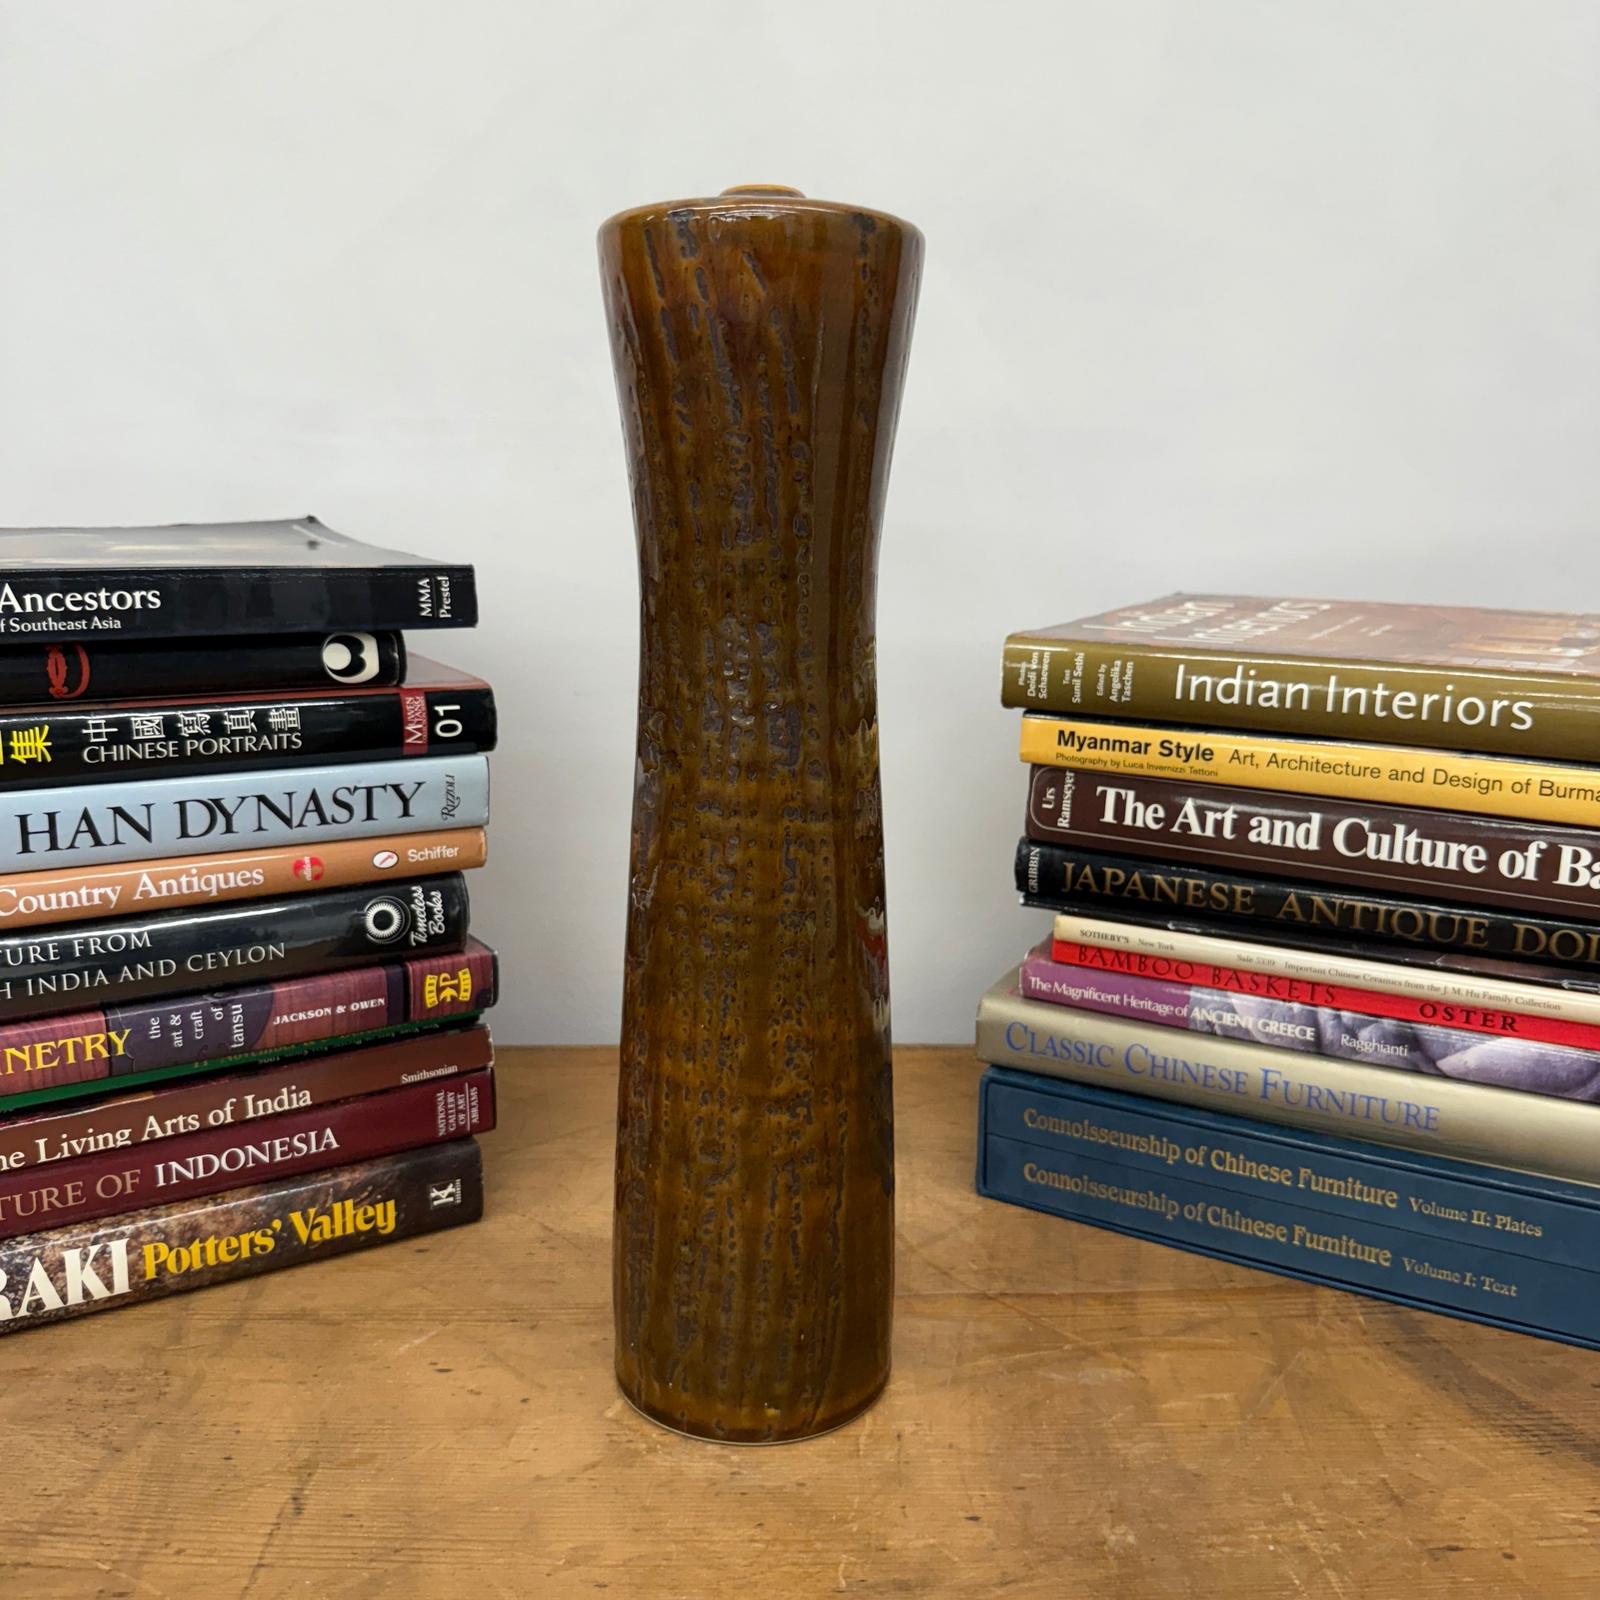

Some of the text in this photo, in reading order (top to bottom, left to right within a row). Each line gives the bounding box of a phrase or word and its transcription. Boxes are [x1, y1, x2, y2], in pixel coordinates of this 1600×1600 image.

[0, 582, 161, 613] Ancestors
[417, 578, 432, 617] MMA
[436, 576, 451, 618] Prestel
[10, 616, 87, 632] Southeast
[91, 615, 122, 630] Asia
[1027, 652, 1039, 697] Deidi von
[1039, 652, 1051, 699] Schaewen
[1072, 652, 1085, 703] Sunil Sethi
[1109, 660, 1122, 702] Angelika
[1121, 661, 1134, 702] Taschen
[1175, 664, 1535, 730] Indian Interiors
[433, 704, 463, 738] 01
[0, 724, 52, 765] 集
[83, 733, 302, 764] CHINESE PORTRAITS
[1056, 752, 1218, 777] Photography by Luca Invernizzi Tettoni
[1057, 729, 1152, 755] Myanmar
[1158, 739, 1214, 763] Style
[1228, 749, 1260, 769] Art,
[1266, 752, 1381, 779] Architecture
[1388, 767, 1425, 784] and
[1433, 768, 1503, 795] Design
[1511, 778, 1532, 794] of
[14, 781, 427, 855] HAN DYNASTY
[1042, 787, 1055, 809] Urs
[1057, 770, 1076, 828] Ramseyer
[408, 846, 460, 862] Schiffer
[1096, 786, 1165, 830] The
[1170, 797, 1238, 840] Art
[1248, 811, 1323, 850] and
[1332, 817, 1488, 874] Culture
[1498, 840, 1548, 882] of
[1028, 847, 1040, 893] GRIBBIN
[0, 868, 265, 918] Country Antiques
[426, 890, 446, 935] Books
[1061, 861, 1255, 915] JAPANESE
[1276, 892, 1489, 948] ANTIQUE
[410, 885, 428, 947] Timeless
[0, 931, 153, 967] URE FROM
[26, 968, 110, 997] INDIA
[119, 958, 177, 984] AND
[186, 941, 286, 974] CEYLON
[1078, 945, 1336, 1004] BAMBOO BASKETS
[1284, 961, 1326, 977] Important
[1328, 968, 1360, 979] Chinese
[1362, 973, 1402, 987] Ceramics
[1403, 980, 1425, 989] from
[1427, 983, 1441, 992] the
[1482, 992, 1512, 1004] Family
[1514, 995, 1562, 1010] Collection
[148, 1016, 162, 1040] the
[170, 1013, 182, 1048] art &
[190, 1008, 204, 1040] craft
[211, 1006, 224, 1021] of
[231, 1003, 244, 1049] tansu
[273, 997, 386, 1026] JACKSON & OWEN
[1029, 976, 1316, 1041] The Magnificent Heritage of ANCIENT GREECE
[1419, 1003, 1519, 1032] OSTER
[0, 1028, 132, 1077] NETRY
[1340, 1033, 1409, 1057] Ragghianti
[401, 1064, 458, 1084] Smithsonian
[1005, 1021, 1441, 1132] CLASSIC CHINESE FURNITURE
[35, 1127, 132, 1165] Living
[140, 1114, 200, 1142] Arts
[208, 1098, 236, 1126] of
[244, 1085, 312, 1119] India
[436, 1088, 446, 1136] NATIONAL
[447, 1091, 456, 1131] GALLERY
[470, 1087, 480, 1124] ABRAMS
[95, 1169, 141, 1198] OF
[154, 1127, 340, 1188] INDONESIA
[1023, 1107, 1543, 1238] Connoisseurship of Chinese Furniture Volume II: Plates
[289, 1198, 397, 1246] Valley
[1023, 1162, 1518, 1298] Connoisseurship of Chinese Furniture Volume I: Text
